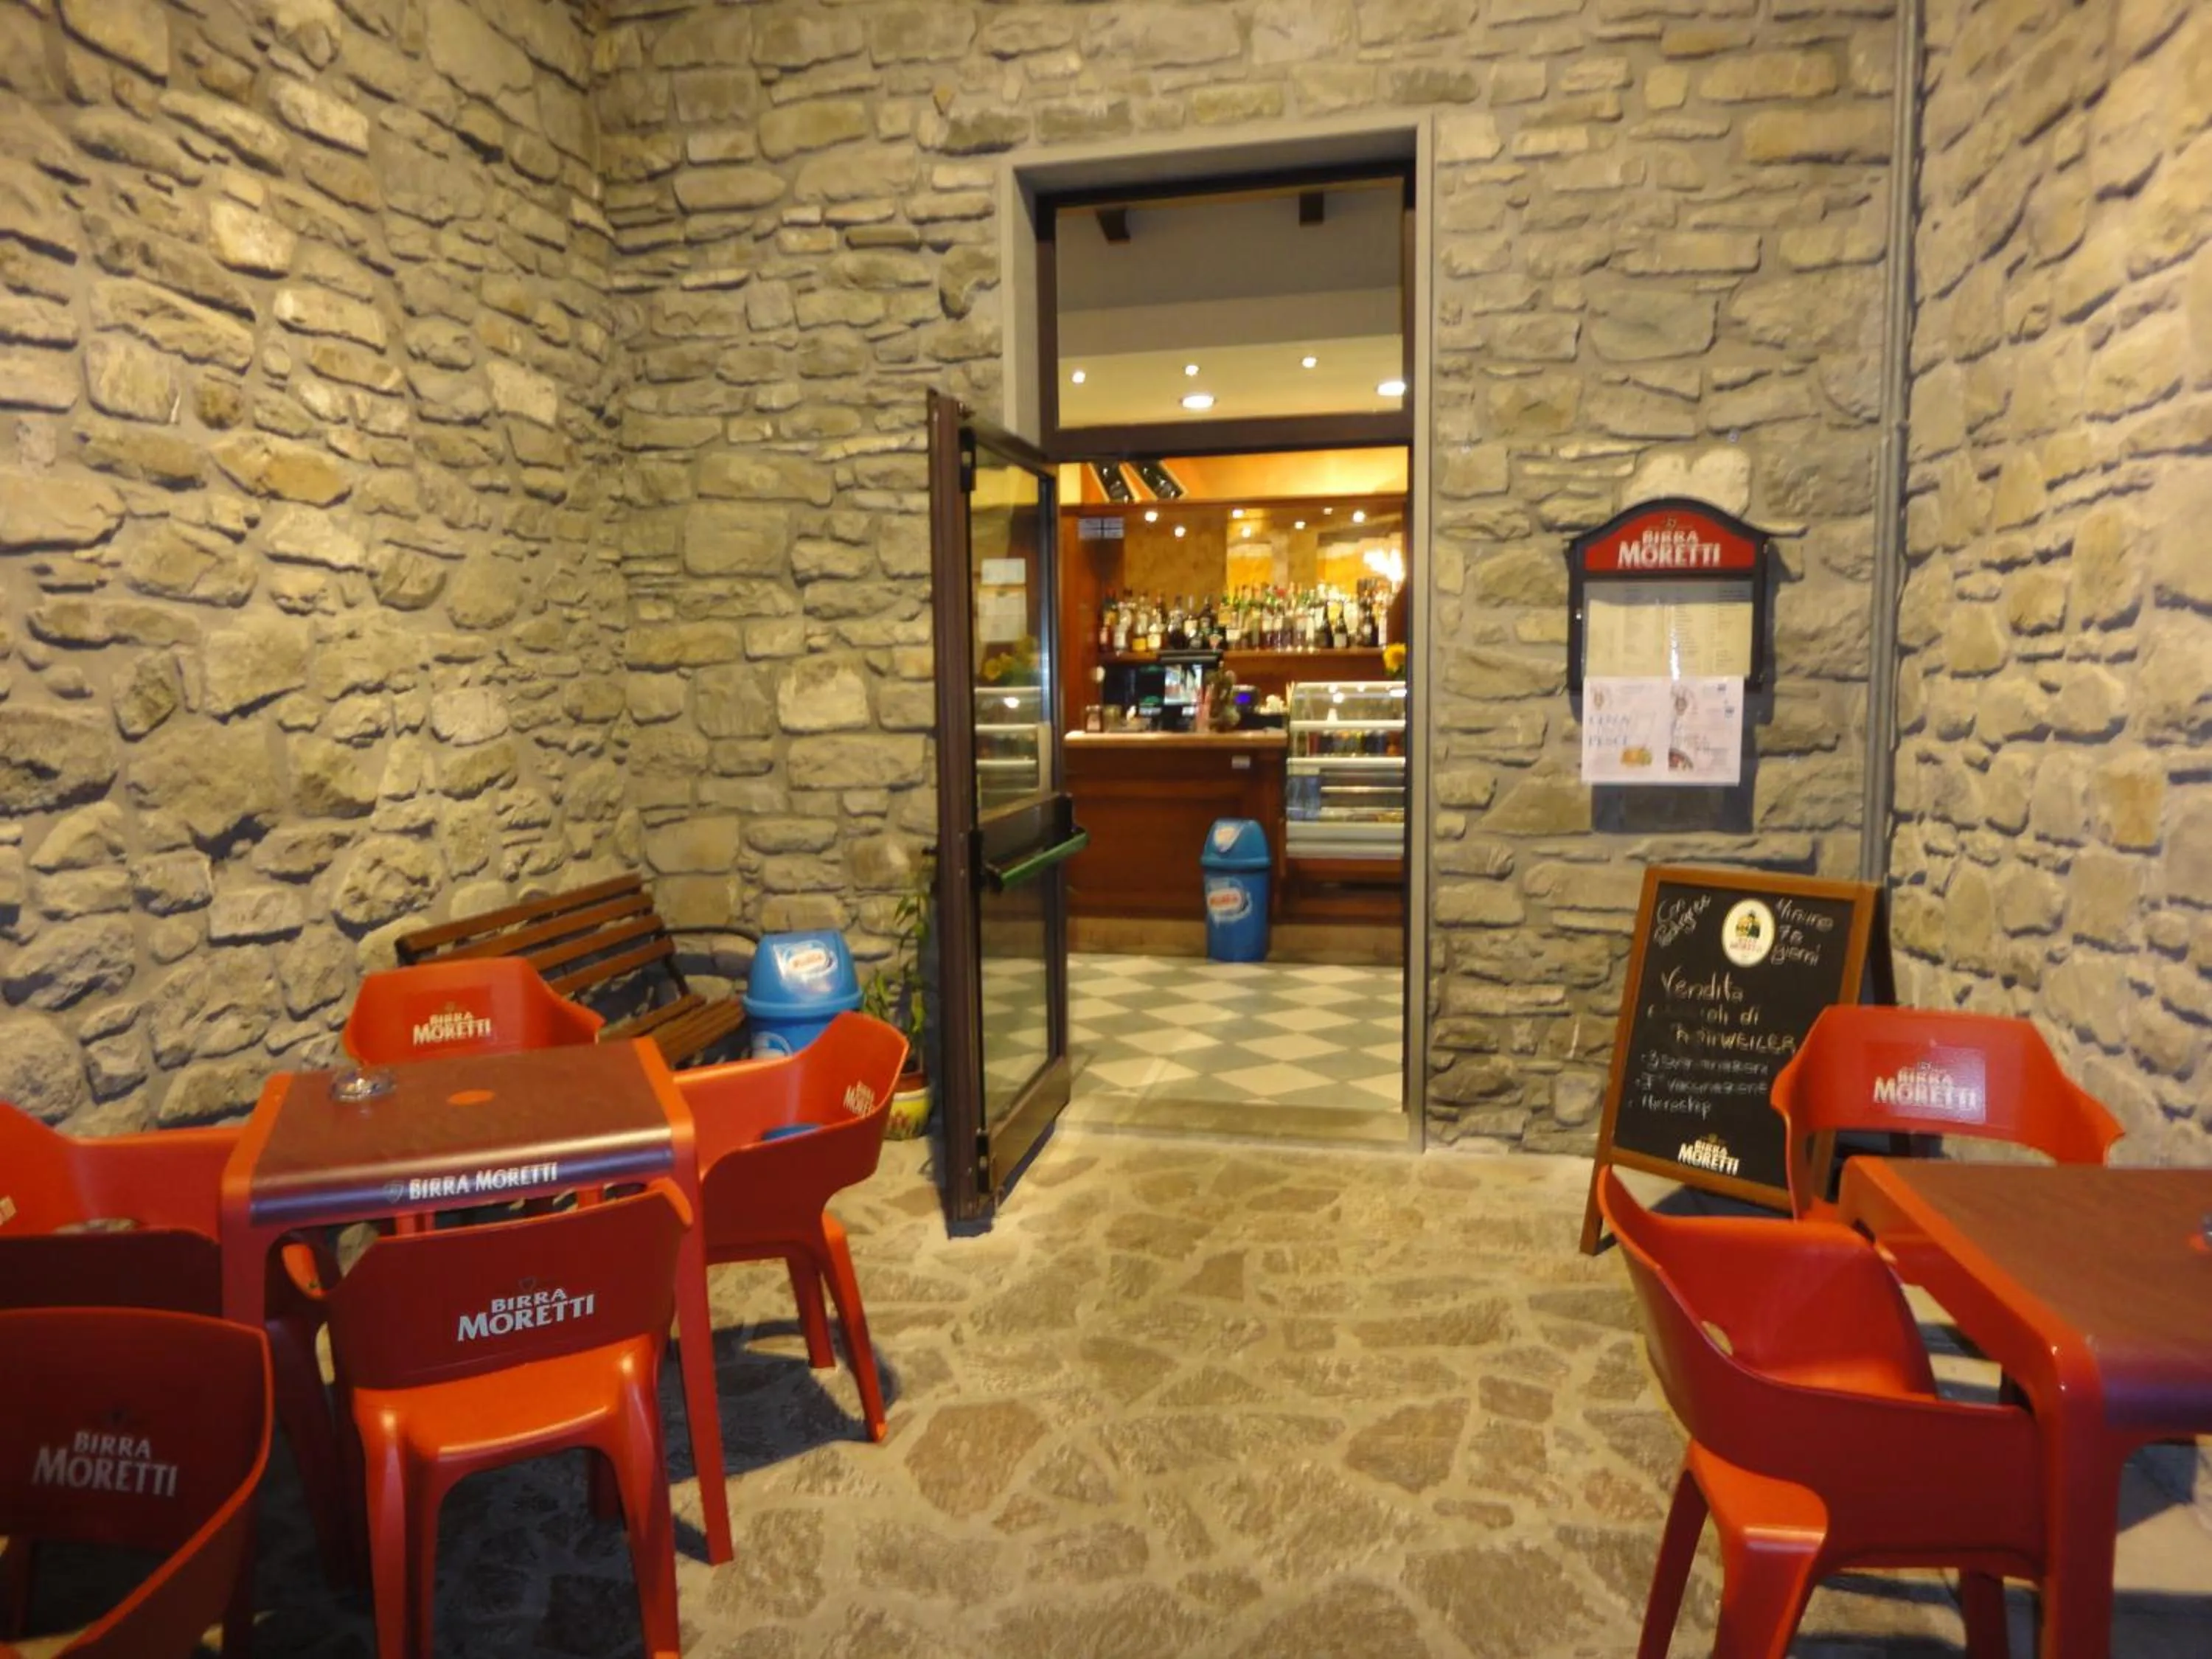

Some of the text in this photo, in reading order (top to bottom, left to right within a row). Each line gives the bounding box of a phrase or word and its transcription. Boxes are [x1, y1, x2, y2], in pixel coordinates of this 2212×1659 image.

[1643, 530, 1699, 543] BIRRA
[1618, 540, 1721, 568] MORETTI
[1661, 966, 1744, 1002] Vendita
[430, 1012, 474, 1024] BIRRA
[1740, 1006, 1759, 1026] di
[414, 1018, 491, 1046] MORETTI
[1897, 1068, 1953, 1084] BIRRA
[1873, 1076, 1978, 1111] MORETTI
[1677, 1143, 1739, 1176] MORETTI
[1694, 1140, 1728, 1157] BIRRA
[409, 1162, 558, 1200] BIRRA MORETTI
[491, 1288, 568, 1313] BIRRA
[457, 1294, 595, 1342] MORETTI
[74, 1430, 150, 1458] BIRRA
[32, 1444, 178, 1497] MORETTI
